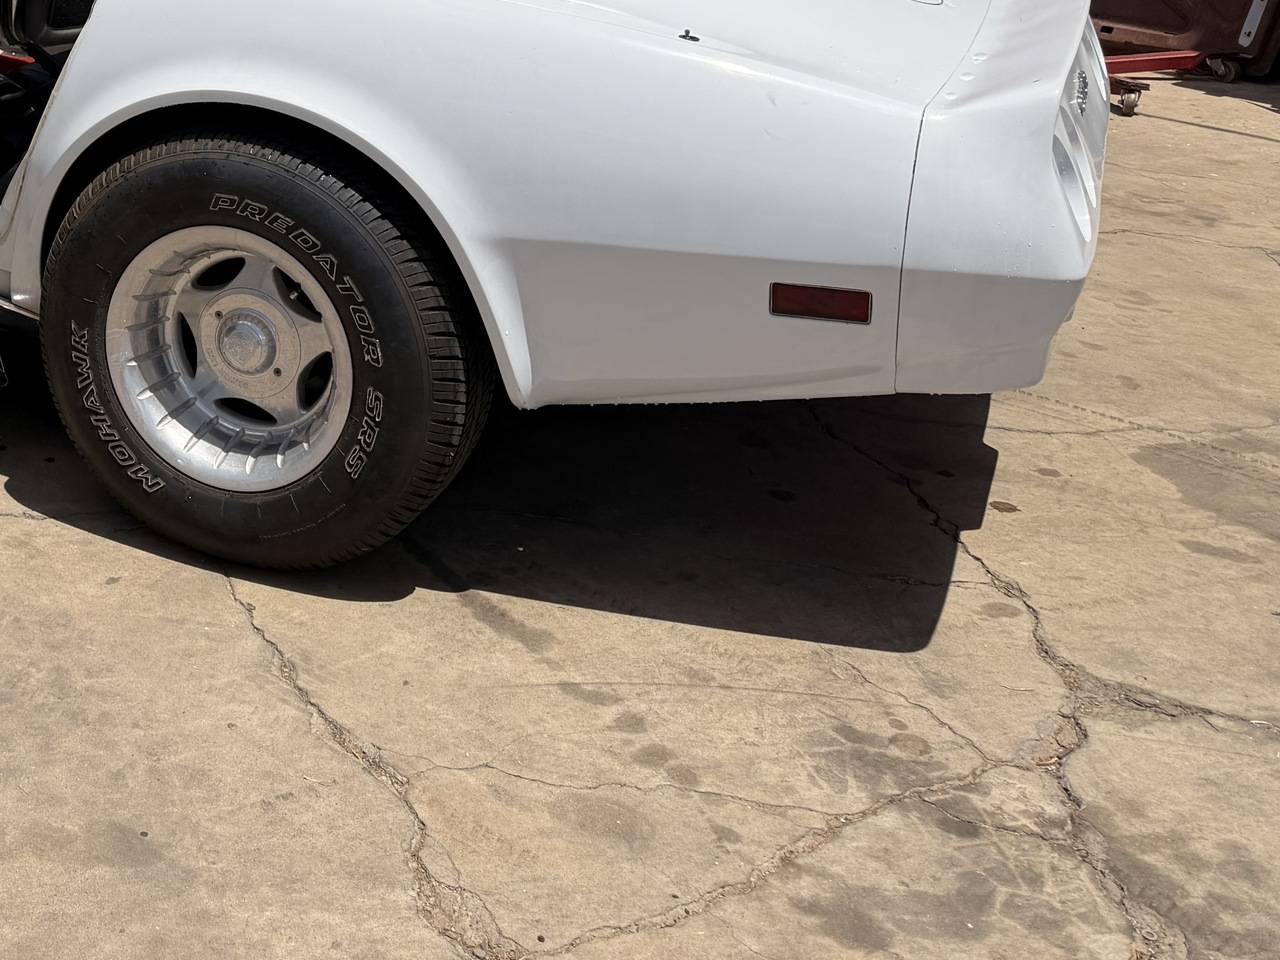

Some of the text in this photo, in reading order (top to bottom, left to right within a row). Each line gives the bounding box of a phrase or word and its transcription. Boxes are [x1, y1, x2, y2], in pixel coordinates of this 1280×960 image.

[71, 319, 166, 494] MOHAWK
[209, 192, 384, 368] PREDATOR
[343, 385, 384, 479] SRS
